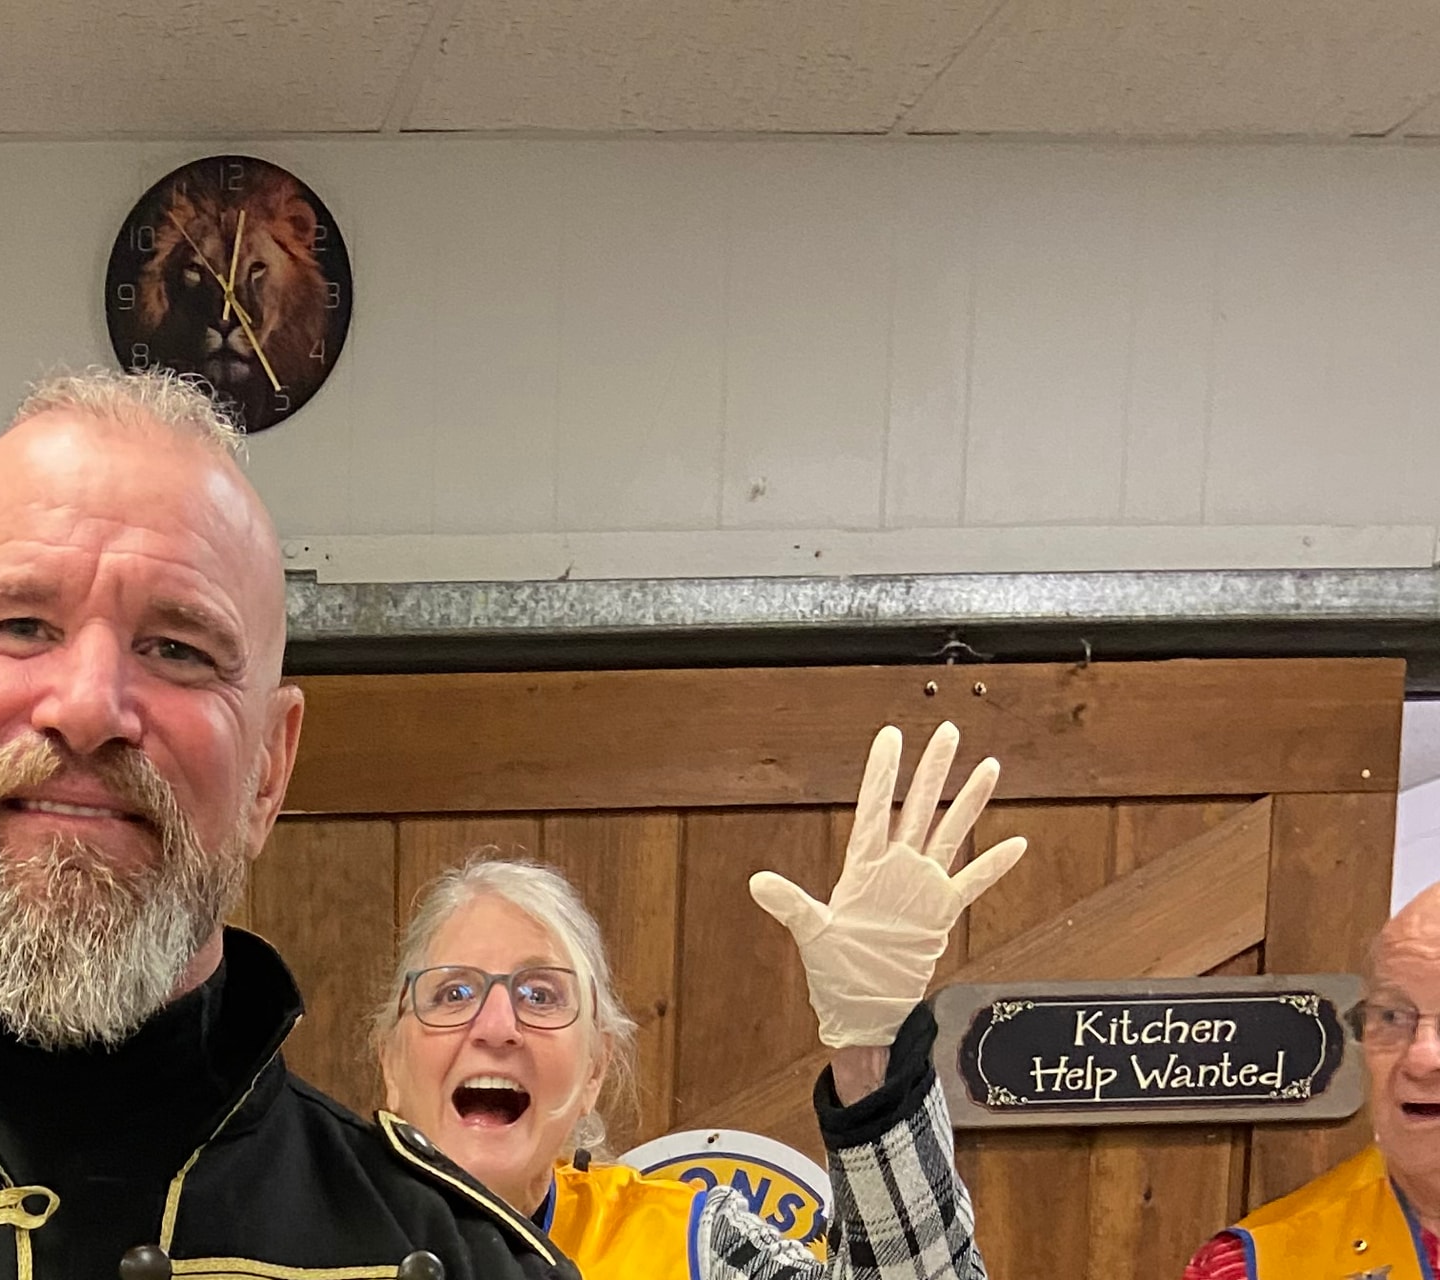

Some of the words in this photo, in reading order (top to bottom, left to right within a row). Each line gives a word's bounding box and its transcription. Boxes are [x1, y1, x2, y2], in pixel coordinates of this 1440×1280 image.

[218, 163, 245, 191] 12
[129, 225, 156, 252] 10
[310, 224, 328, 252] 2
[116, 283, 136, 311] 9
[324, 281, 341, 309] 3
[309, 338, 326, 365] 4
[1073, 1009, 1238, 1047] Kitchen
[1029, 1054, 1118, 1101] Help
[1129, 1050, 1285, 1091] Wanted
[679, 1166, 806, 1233] ONS
